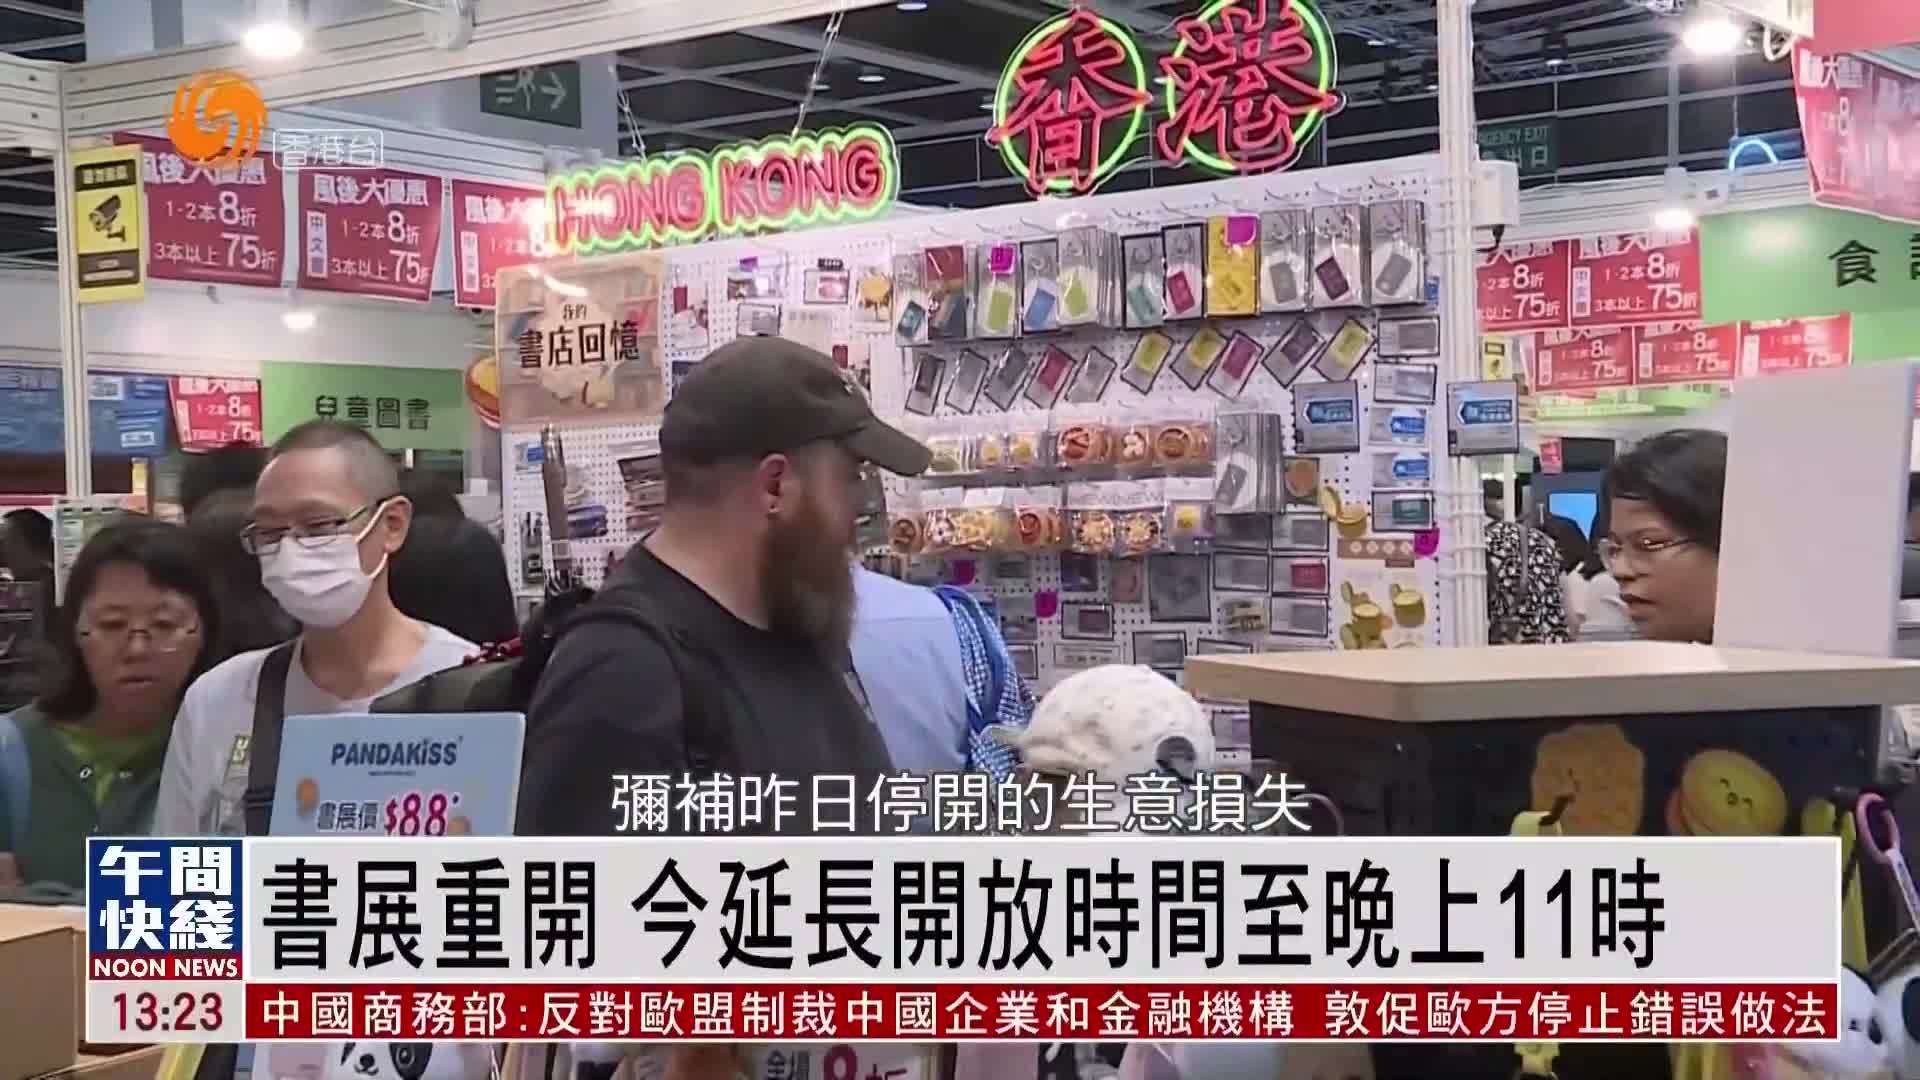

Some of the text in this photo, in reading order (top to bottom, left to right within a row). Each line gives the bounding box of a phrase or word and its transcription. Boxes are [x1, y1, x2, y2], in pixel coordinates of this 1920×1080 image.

[985, 0, 1340, 193] 香港
[166, 191, 257, 227] 1-2本8折
[553, 138, 886, 251] HONG KONG
[342, 210, 422, 245] 1-2本8折
[154, 232, 277, 271] 3本以上75折
[518, 318, 642, 370] 書店回憶
